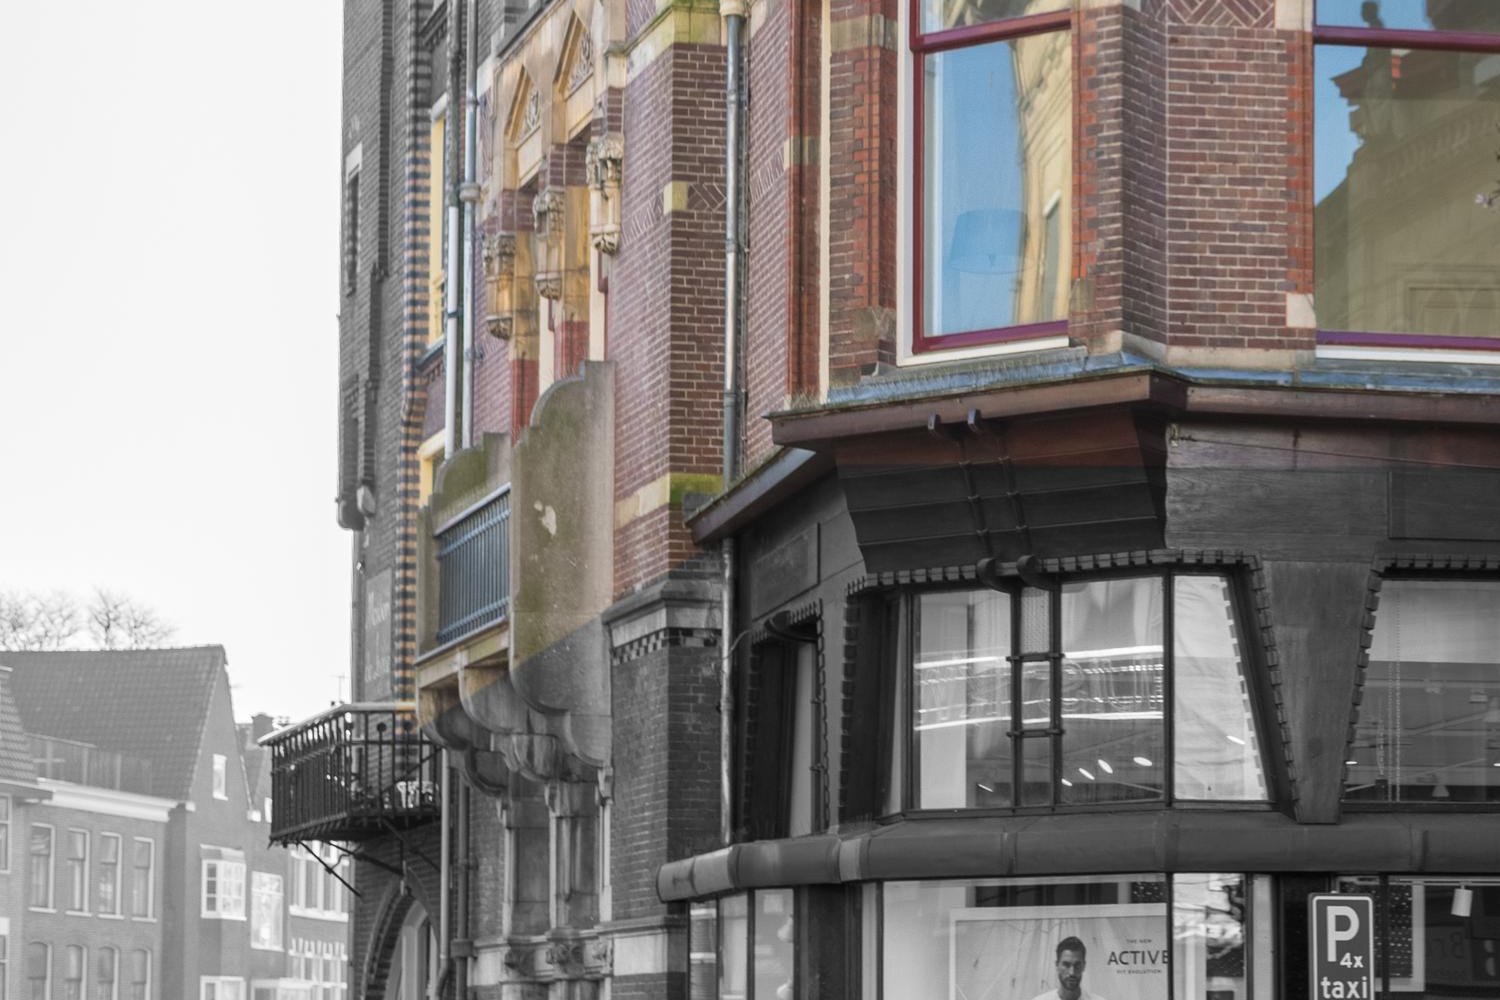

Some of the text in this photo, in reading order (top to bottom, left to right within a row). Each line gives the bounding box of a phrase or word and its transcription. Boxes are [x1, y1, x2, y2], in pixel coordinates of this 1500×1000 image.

[1326, 905, 1360, 962] P
[1107, 950, 1169, 965] ACTIVE
[1339, 952, 1364, 968] 4x
[1320, 976, 1368, 999] taxi
